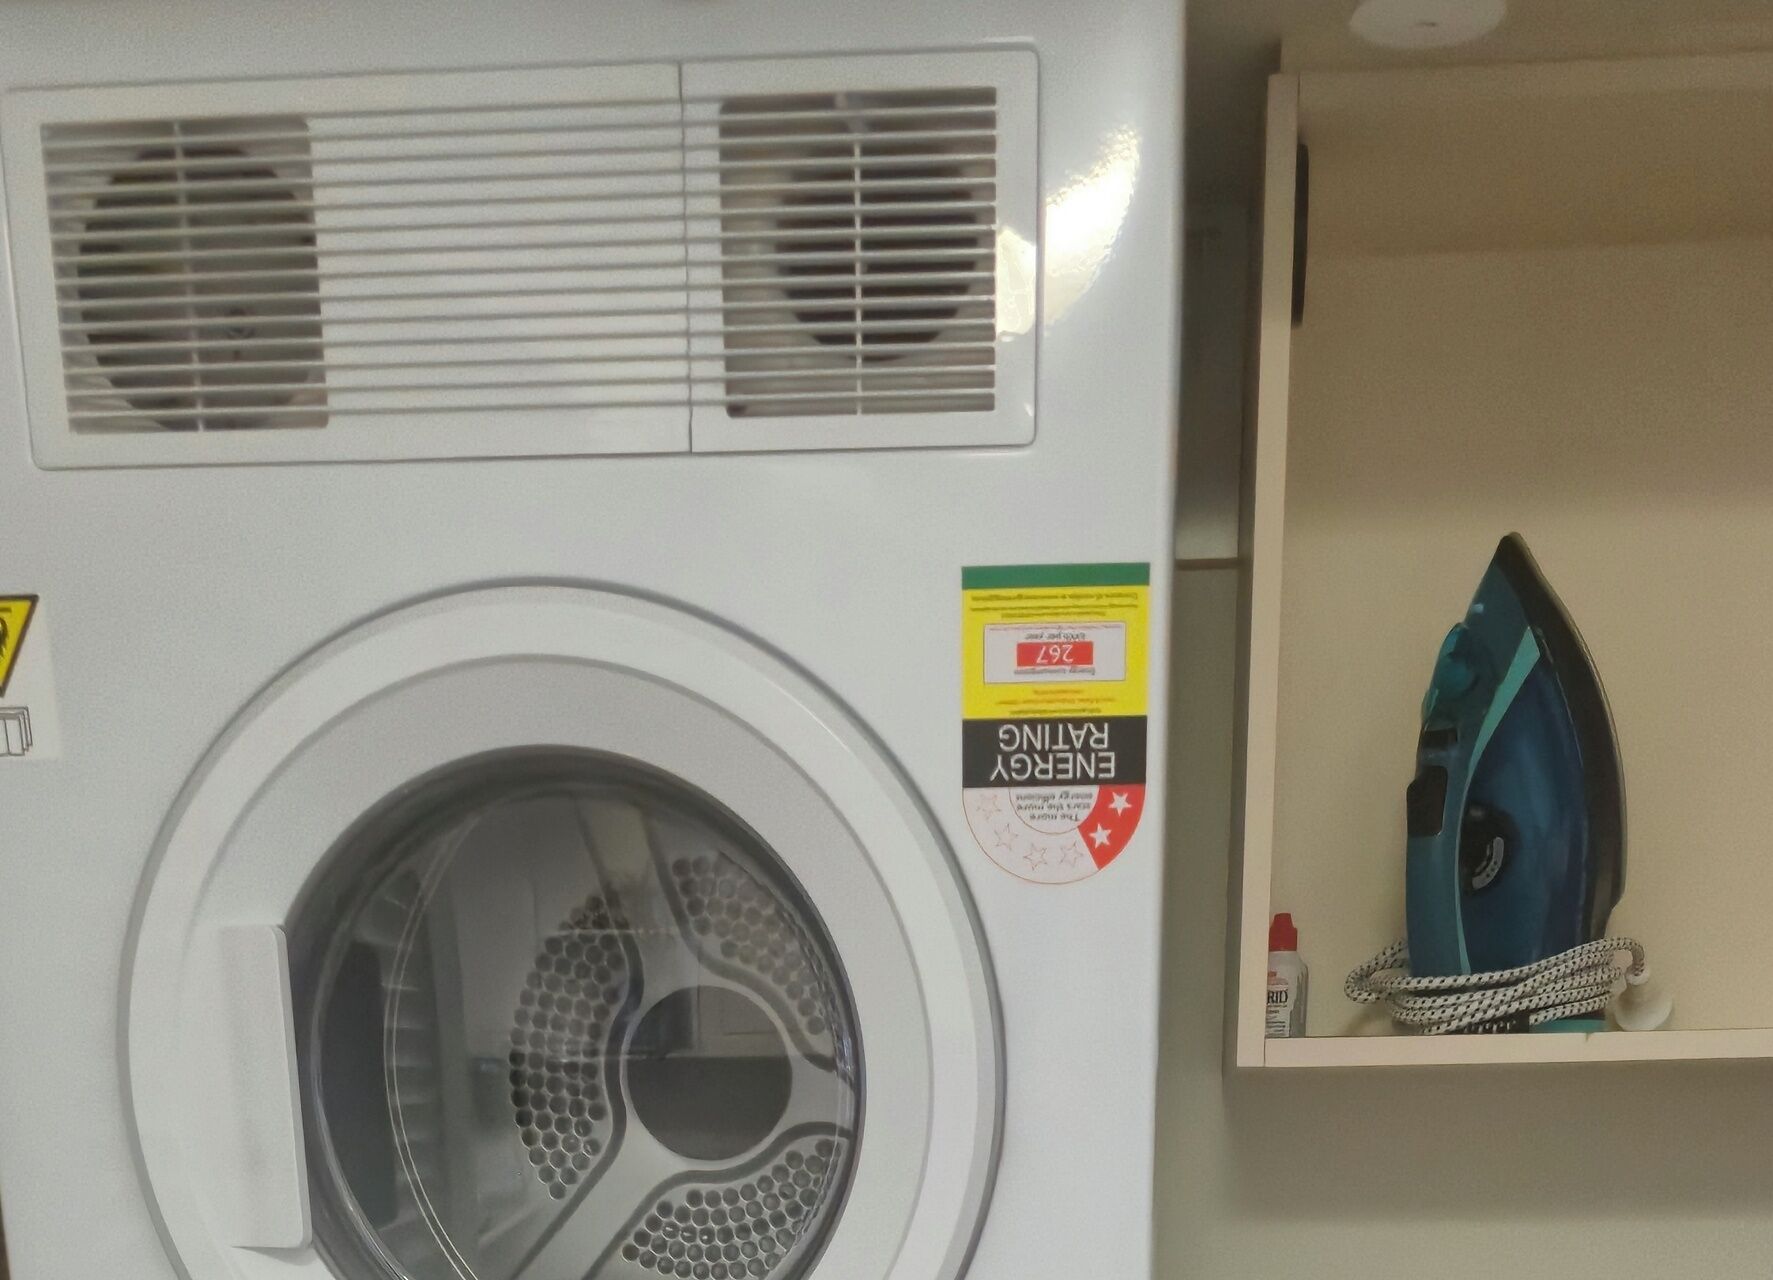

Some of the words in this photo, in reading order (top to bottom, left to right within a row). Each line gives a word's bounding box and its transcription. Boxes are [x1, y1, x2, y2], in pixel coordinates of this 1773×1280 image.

[1036, 643, 1074, 665] 267
[998, 723, 1110, 752] RATING
[990, 752, 1117, 782] ENERGY
